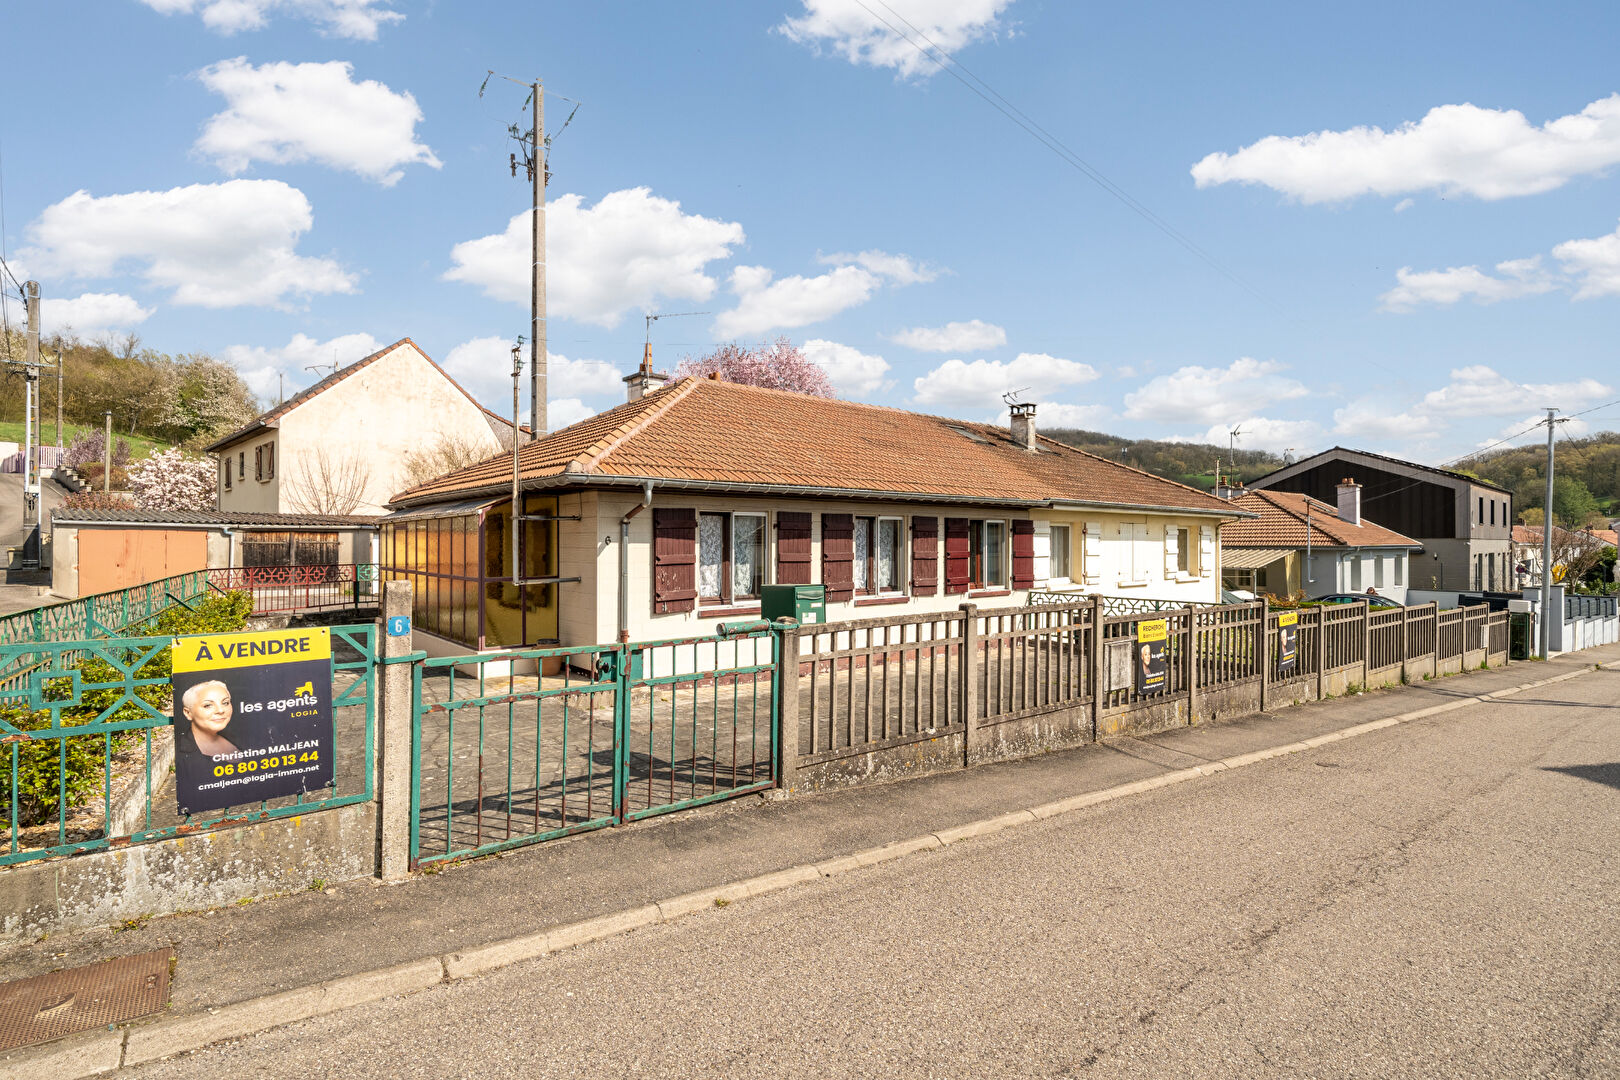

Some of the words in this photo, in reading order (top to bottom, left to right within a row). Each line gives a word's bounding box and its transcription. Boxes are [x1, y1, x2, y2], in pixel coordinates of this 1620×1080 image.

[605, 535, 612, 546] 6
[395, 619, 403, 633] 6
[195, 640, 213, 662] À
[218, 637, 311, 659] VENDRE
[240, 701, 263, 714] les
[267, 693, 318, 712] agents
[290, 709, 318, 718] LOGIA
[212, 749, 267, 763] Christine
[268, 739, 319, 755] MALJEAN
[213, 764, 235, 777] 06
[237, 760, 258, 774] 80
[260, 757, 280, 770] 30
[281, 754, 297, 766] 13
[299, 750, 319, 763] 44
[198, 764, 320, 791] cmaljean@logia-immo.net
